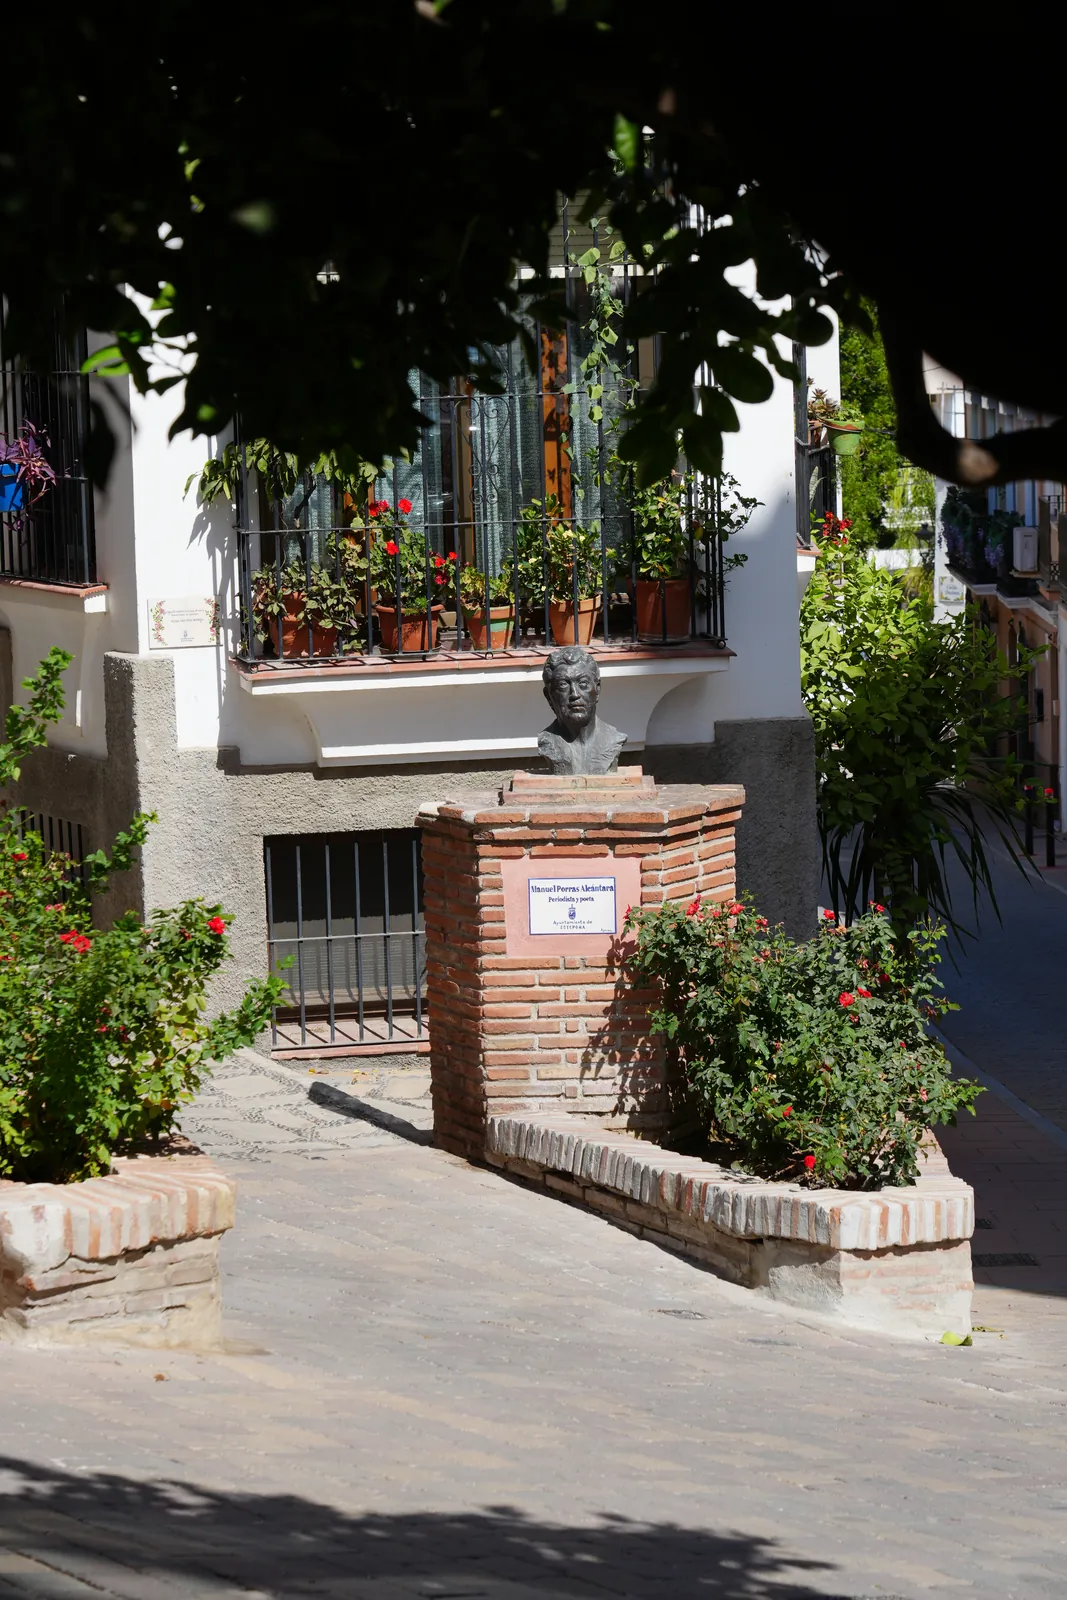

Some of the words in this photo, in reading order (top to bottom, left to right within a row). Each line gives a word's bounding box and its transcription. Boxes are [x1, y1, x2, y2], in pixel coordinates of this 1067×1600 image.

[531, 885, 556, 893] Manuel
[556, 885, 580, 893] Porras
[580, 884, 614, 892] Alcántara
